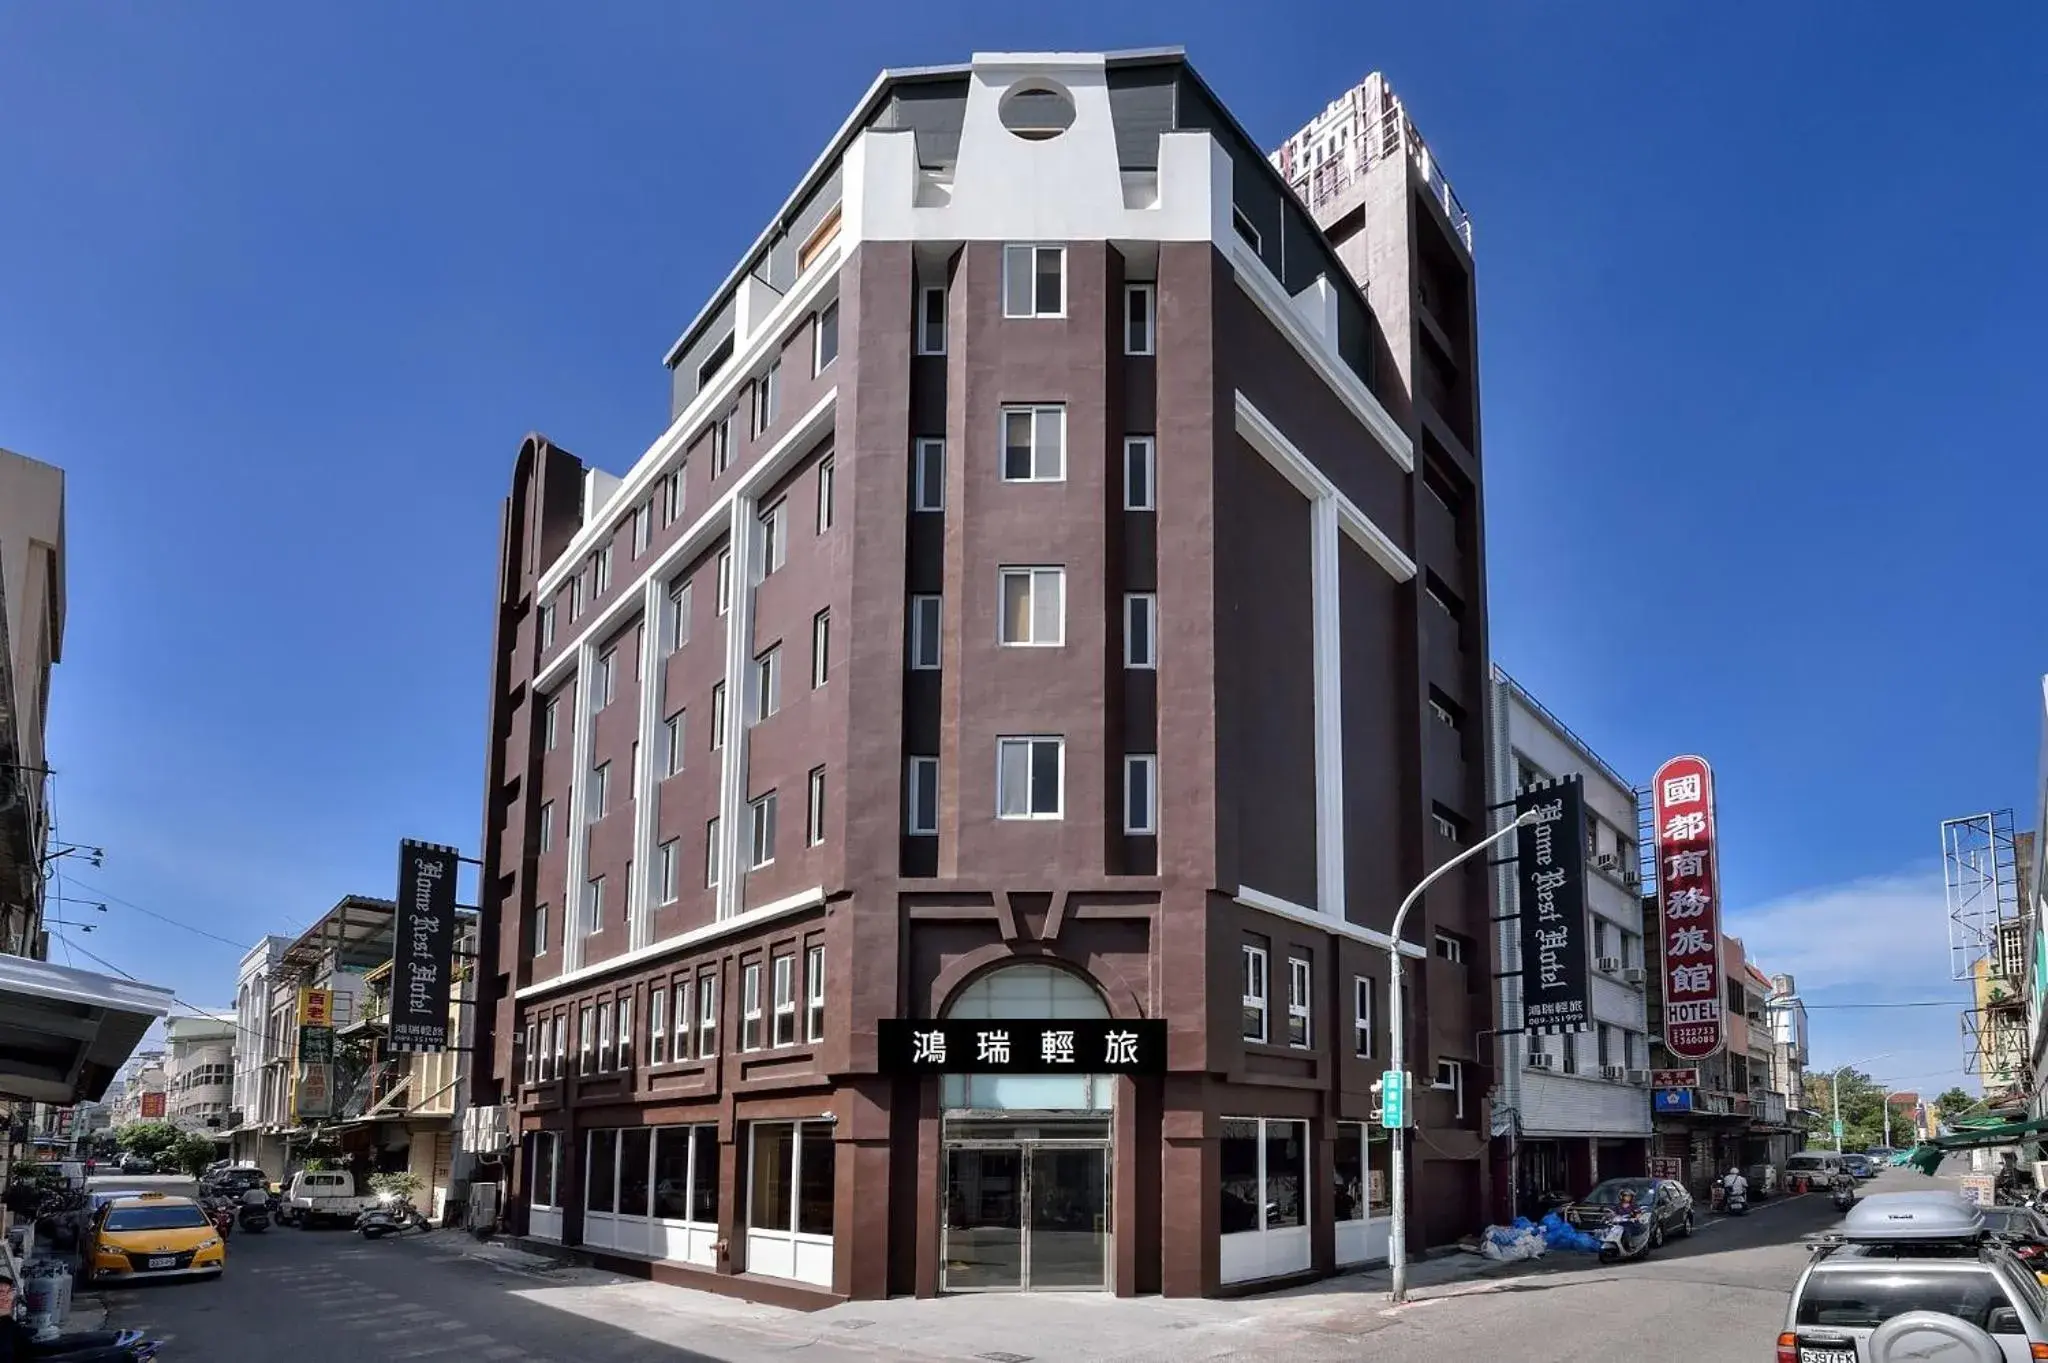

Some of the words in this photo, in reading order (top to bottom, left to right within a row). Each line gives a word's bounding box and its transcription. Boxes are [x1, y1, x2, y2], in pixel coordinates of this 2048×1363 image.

[1532, 798, 1563, 866] Home
[414, 857, 443, 912] Home
[1531, 867, 1567, 922] Rest
[1663, 774, 1713, 994] 國都商務旅館
[409, 914, 440, 959] Rest
[1535, 925, 1569, 989] Hotel
[407, 961, 437, 1015] Hotel
[1668, 1002, 1717, 1022] HOTEL
[912, 1029, 1140, 1064] 鴻瑞輕旅
